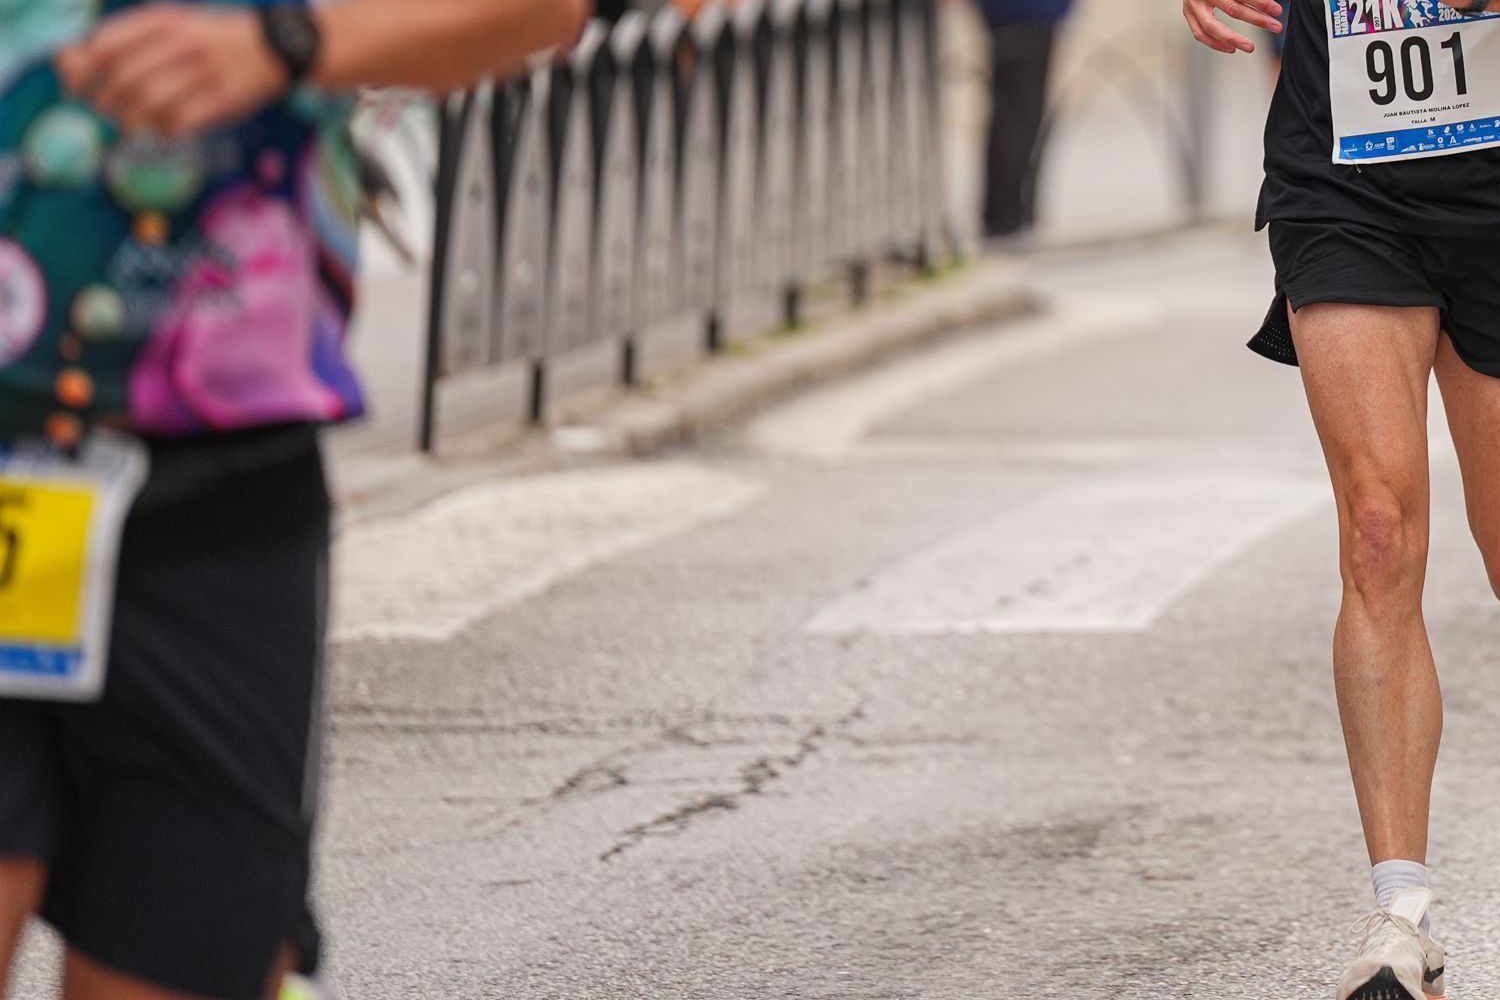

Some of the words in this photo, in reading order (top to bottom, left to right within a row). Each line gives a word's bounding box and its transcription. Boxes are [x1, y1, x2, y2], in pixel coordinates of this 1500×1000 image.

[1333, 9, 1341, 36] MEDIA
[1365, 31, 1468, 106] 901
[1398, 108, 1428, 117] BAUTISTA
[1428, 105, 1451, 113] MOLINA
[1452, 102, 1470, 110] LOPEZ
